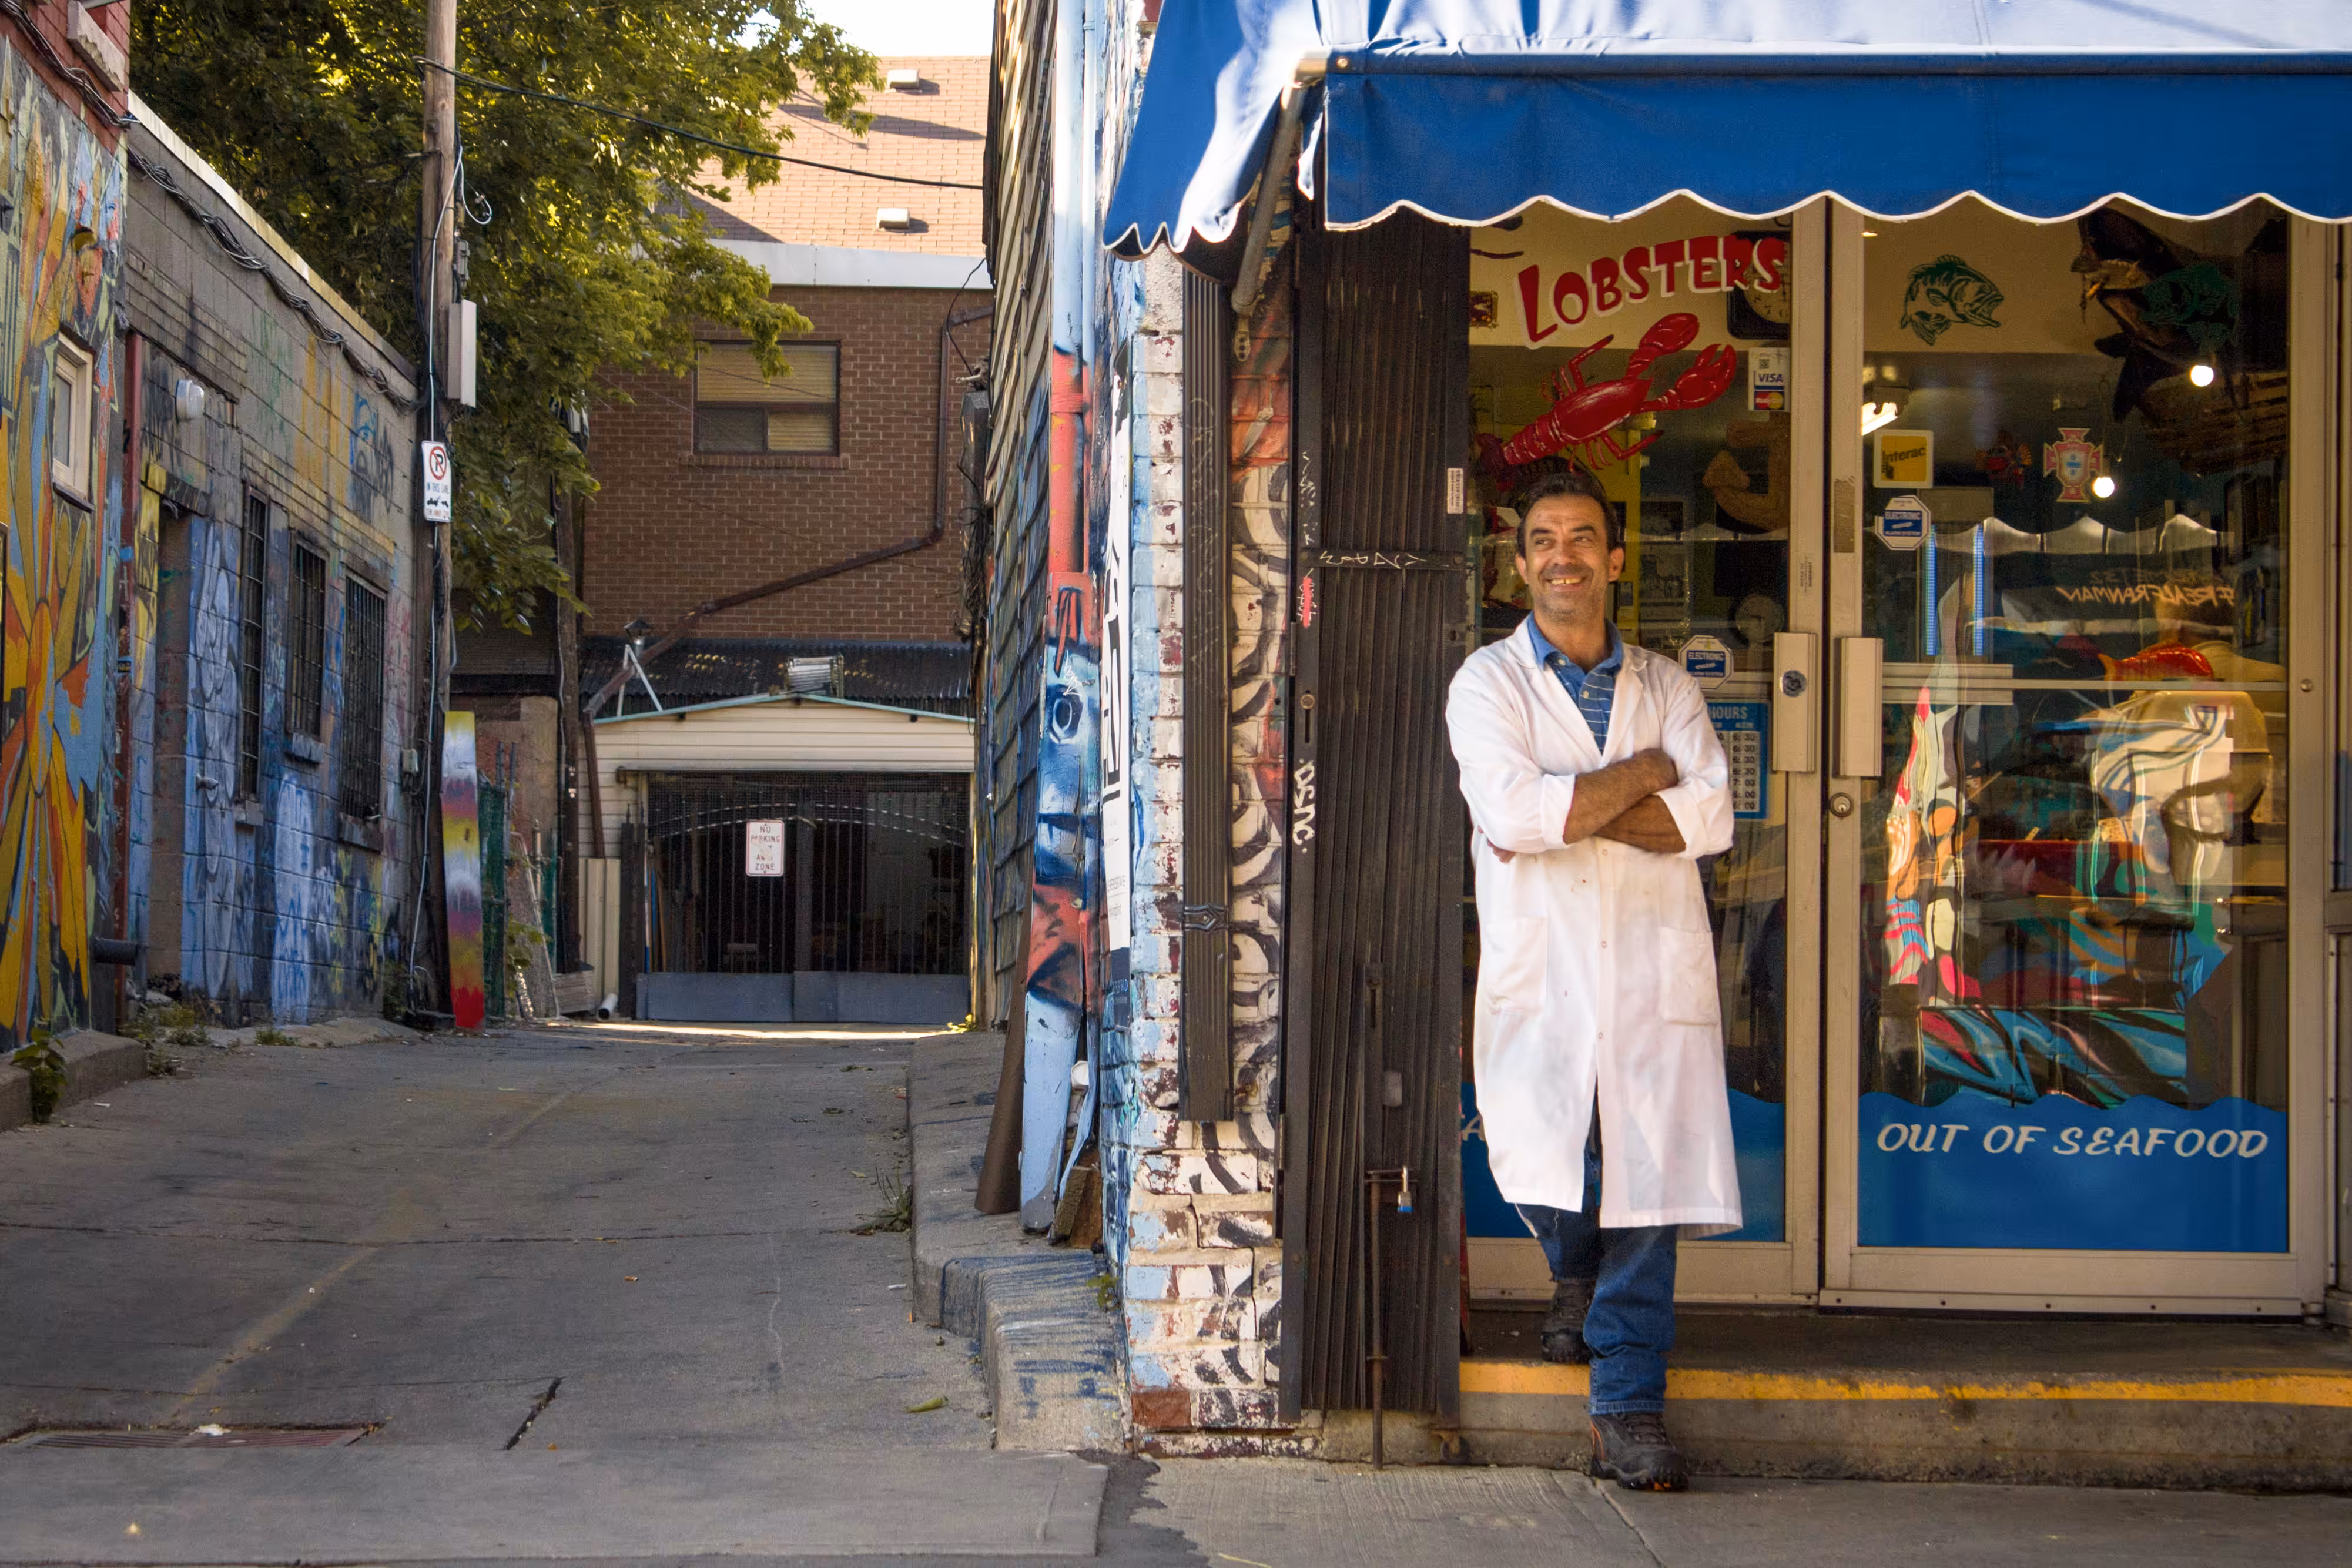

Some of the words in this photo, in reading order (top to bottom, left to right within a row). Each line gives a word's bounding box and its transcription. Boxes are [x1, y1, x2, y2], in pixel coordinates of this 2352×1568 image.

[1516, 235, 1786, 348] LOBSTERS
[1758, 373, 1783, 383] VISA
[1882, 447, 1927, 463] Interac
[1885, 511, 1921, 520] ELECTRONIC
[1688, 652, 1724, 661] ELECTRONIC
[1708, 706, 1748, 720] HOURS
[1878, 1123, 1969, 1153] OUT
[1983, 1125, 2046, 1154] OF
[2053, 1126, 2269, 1158] SEAFOOD
